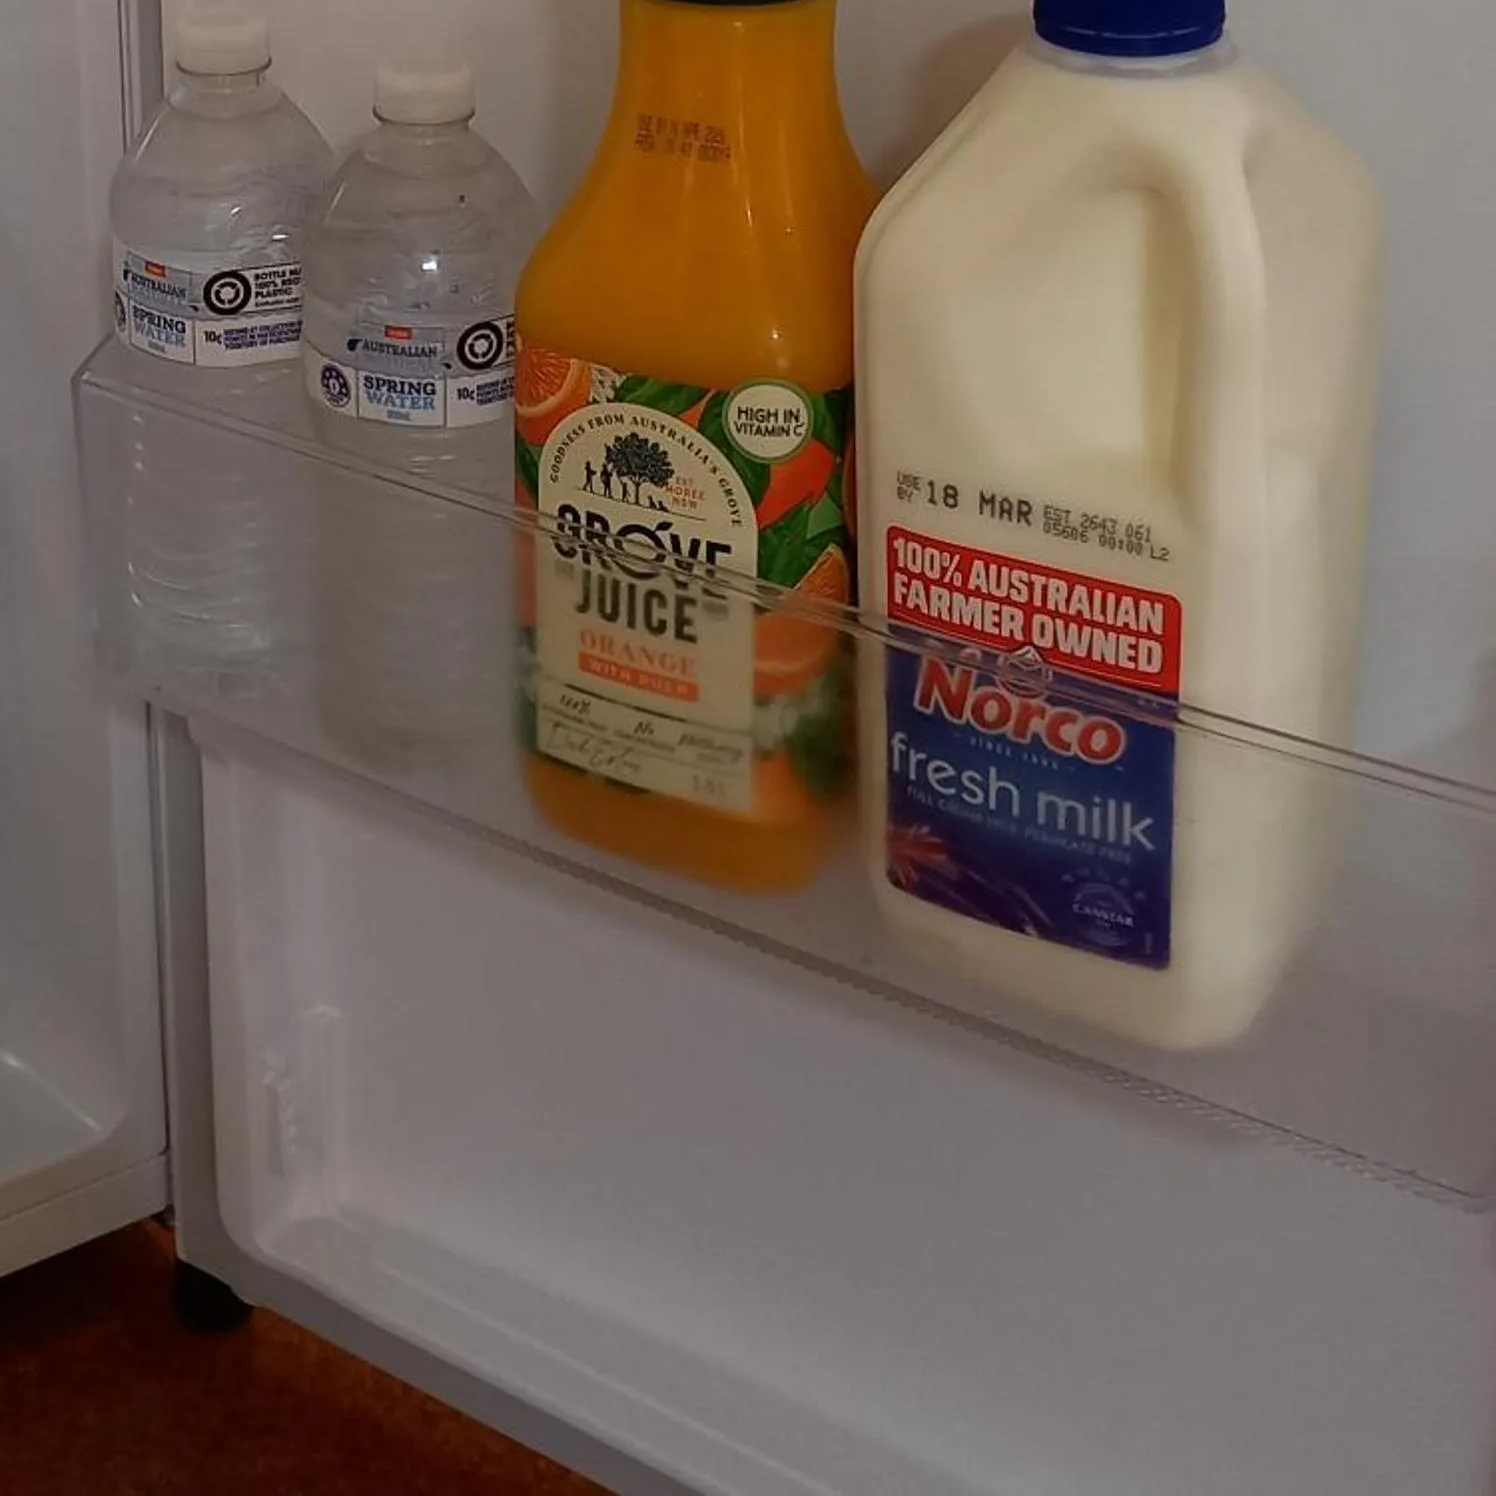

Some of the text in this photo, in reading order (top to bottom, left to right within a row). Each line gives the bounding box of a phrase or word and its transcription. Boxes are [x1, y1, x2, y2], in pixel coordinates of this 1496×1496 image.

[133, 305, 187, 334] SPRING
[133, 319, 186, 347] WATER
[362, 339, 437, 358] AUSTRALIAN
[363, 375, 437, 396] SPRING
[366, 390, 436, 410] WATER
[734, 420, 804, 437] VITAMIN C
[737, 406, 801, 424] HIGH IN
[549, 413, 744, 528] GOODNESS FROM AUSTRALIA'S GROVE
[896, 470, 922, 491] USE
[896, 486, 914, 502] BY
[927, 479, 1033, 526] 18 MAR
[1044, 505, 1071, 524] EST
[555, 504, 732, 594] GROVE
[892, 537, 1164, 636] 100% AUSTRALIAN
[575, 567, 698, 644] JUICE
[893, 571, 1164, 674] FARMER OWNED
[579, 628, 698, 678] ORANGE
[588, 657, 631, 681] WITH
[914, 654, 1128, 766] Norco
[890, 731, 1156, 851] fresh milk
